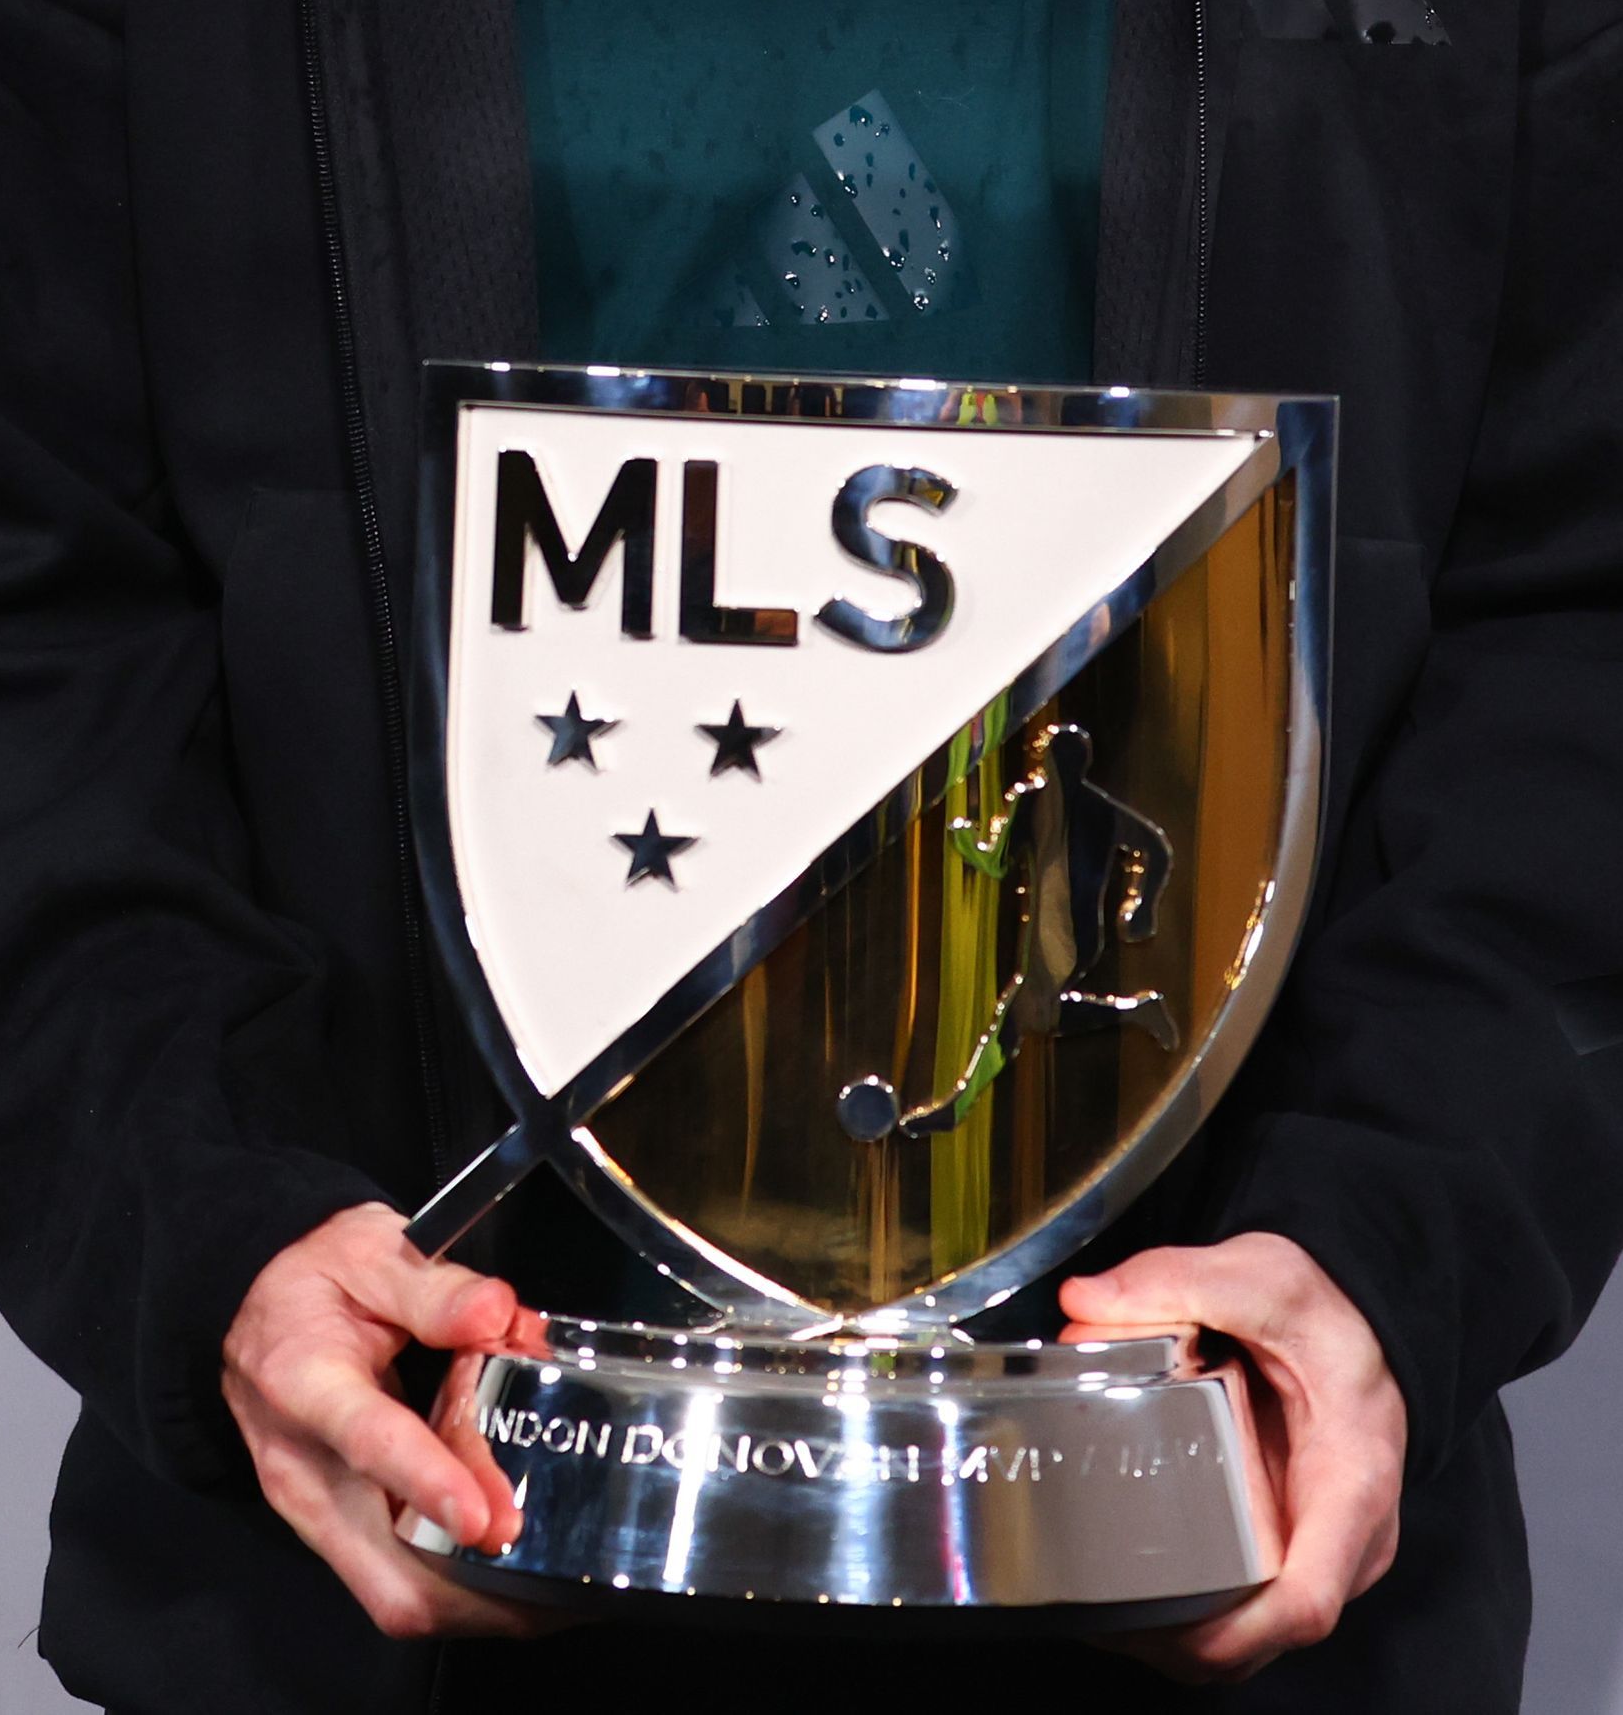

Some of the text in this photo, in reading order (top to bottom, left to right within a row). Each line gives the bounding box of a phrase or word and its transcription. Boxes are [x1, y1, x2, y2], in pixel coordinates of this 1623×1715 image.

[490, 447, 960, 654] MLS
[479, 1405, 612, 1459] NDON
[620, 1422, 921, 1483] DONOVN
